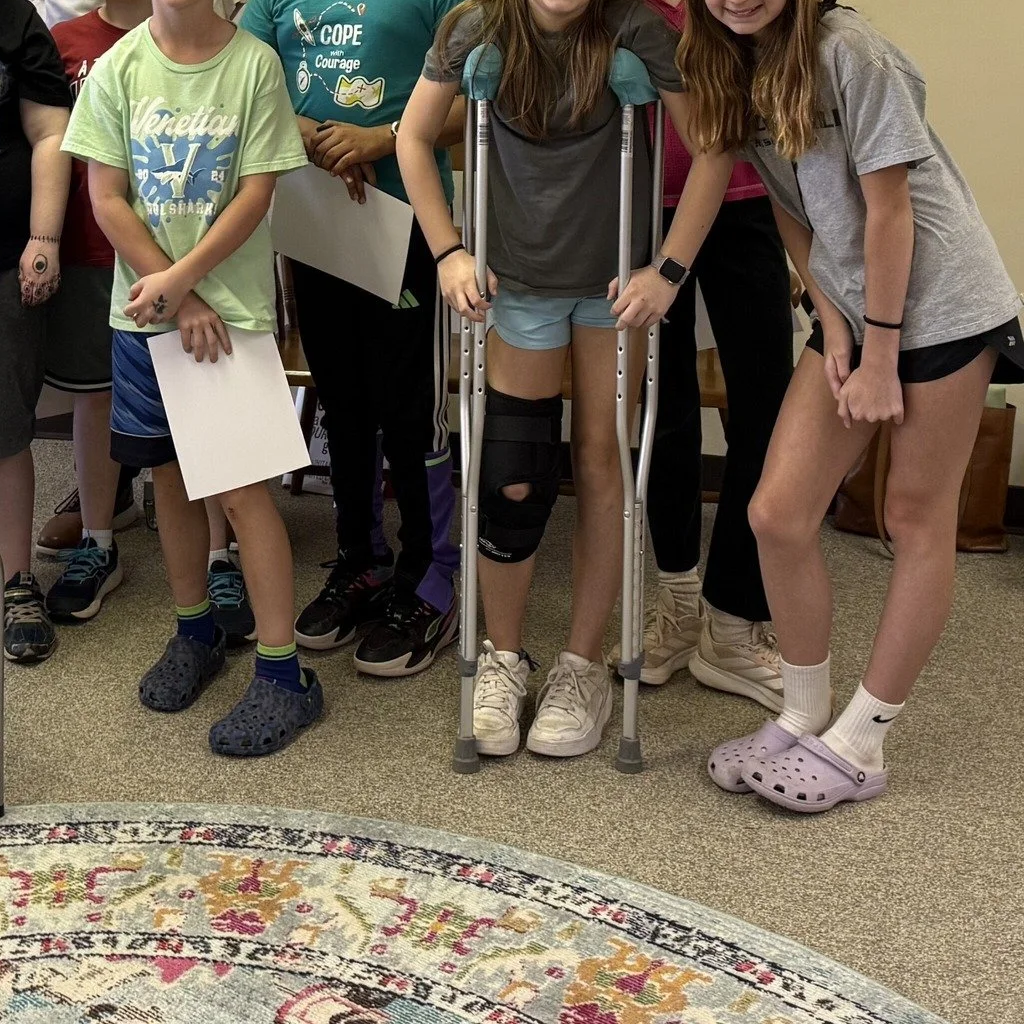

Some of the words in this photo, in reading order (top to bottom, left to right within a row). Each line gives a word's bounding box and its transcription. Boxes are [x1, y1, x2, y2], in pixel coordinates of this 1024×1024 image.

[320, 23, 363, 45] COPE
[330, 49, 345, 57] with
[315, 54, 361, 73] Courage
[211, 170, 225, 181] 24
